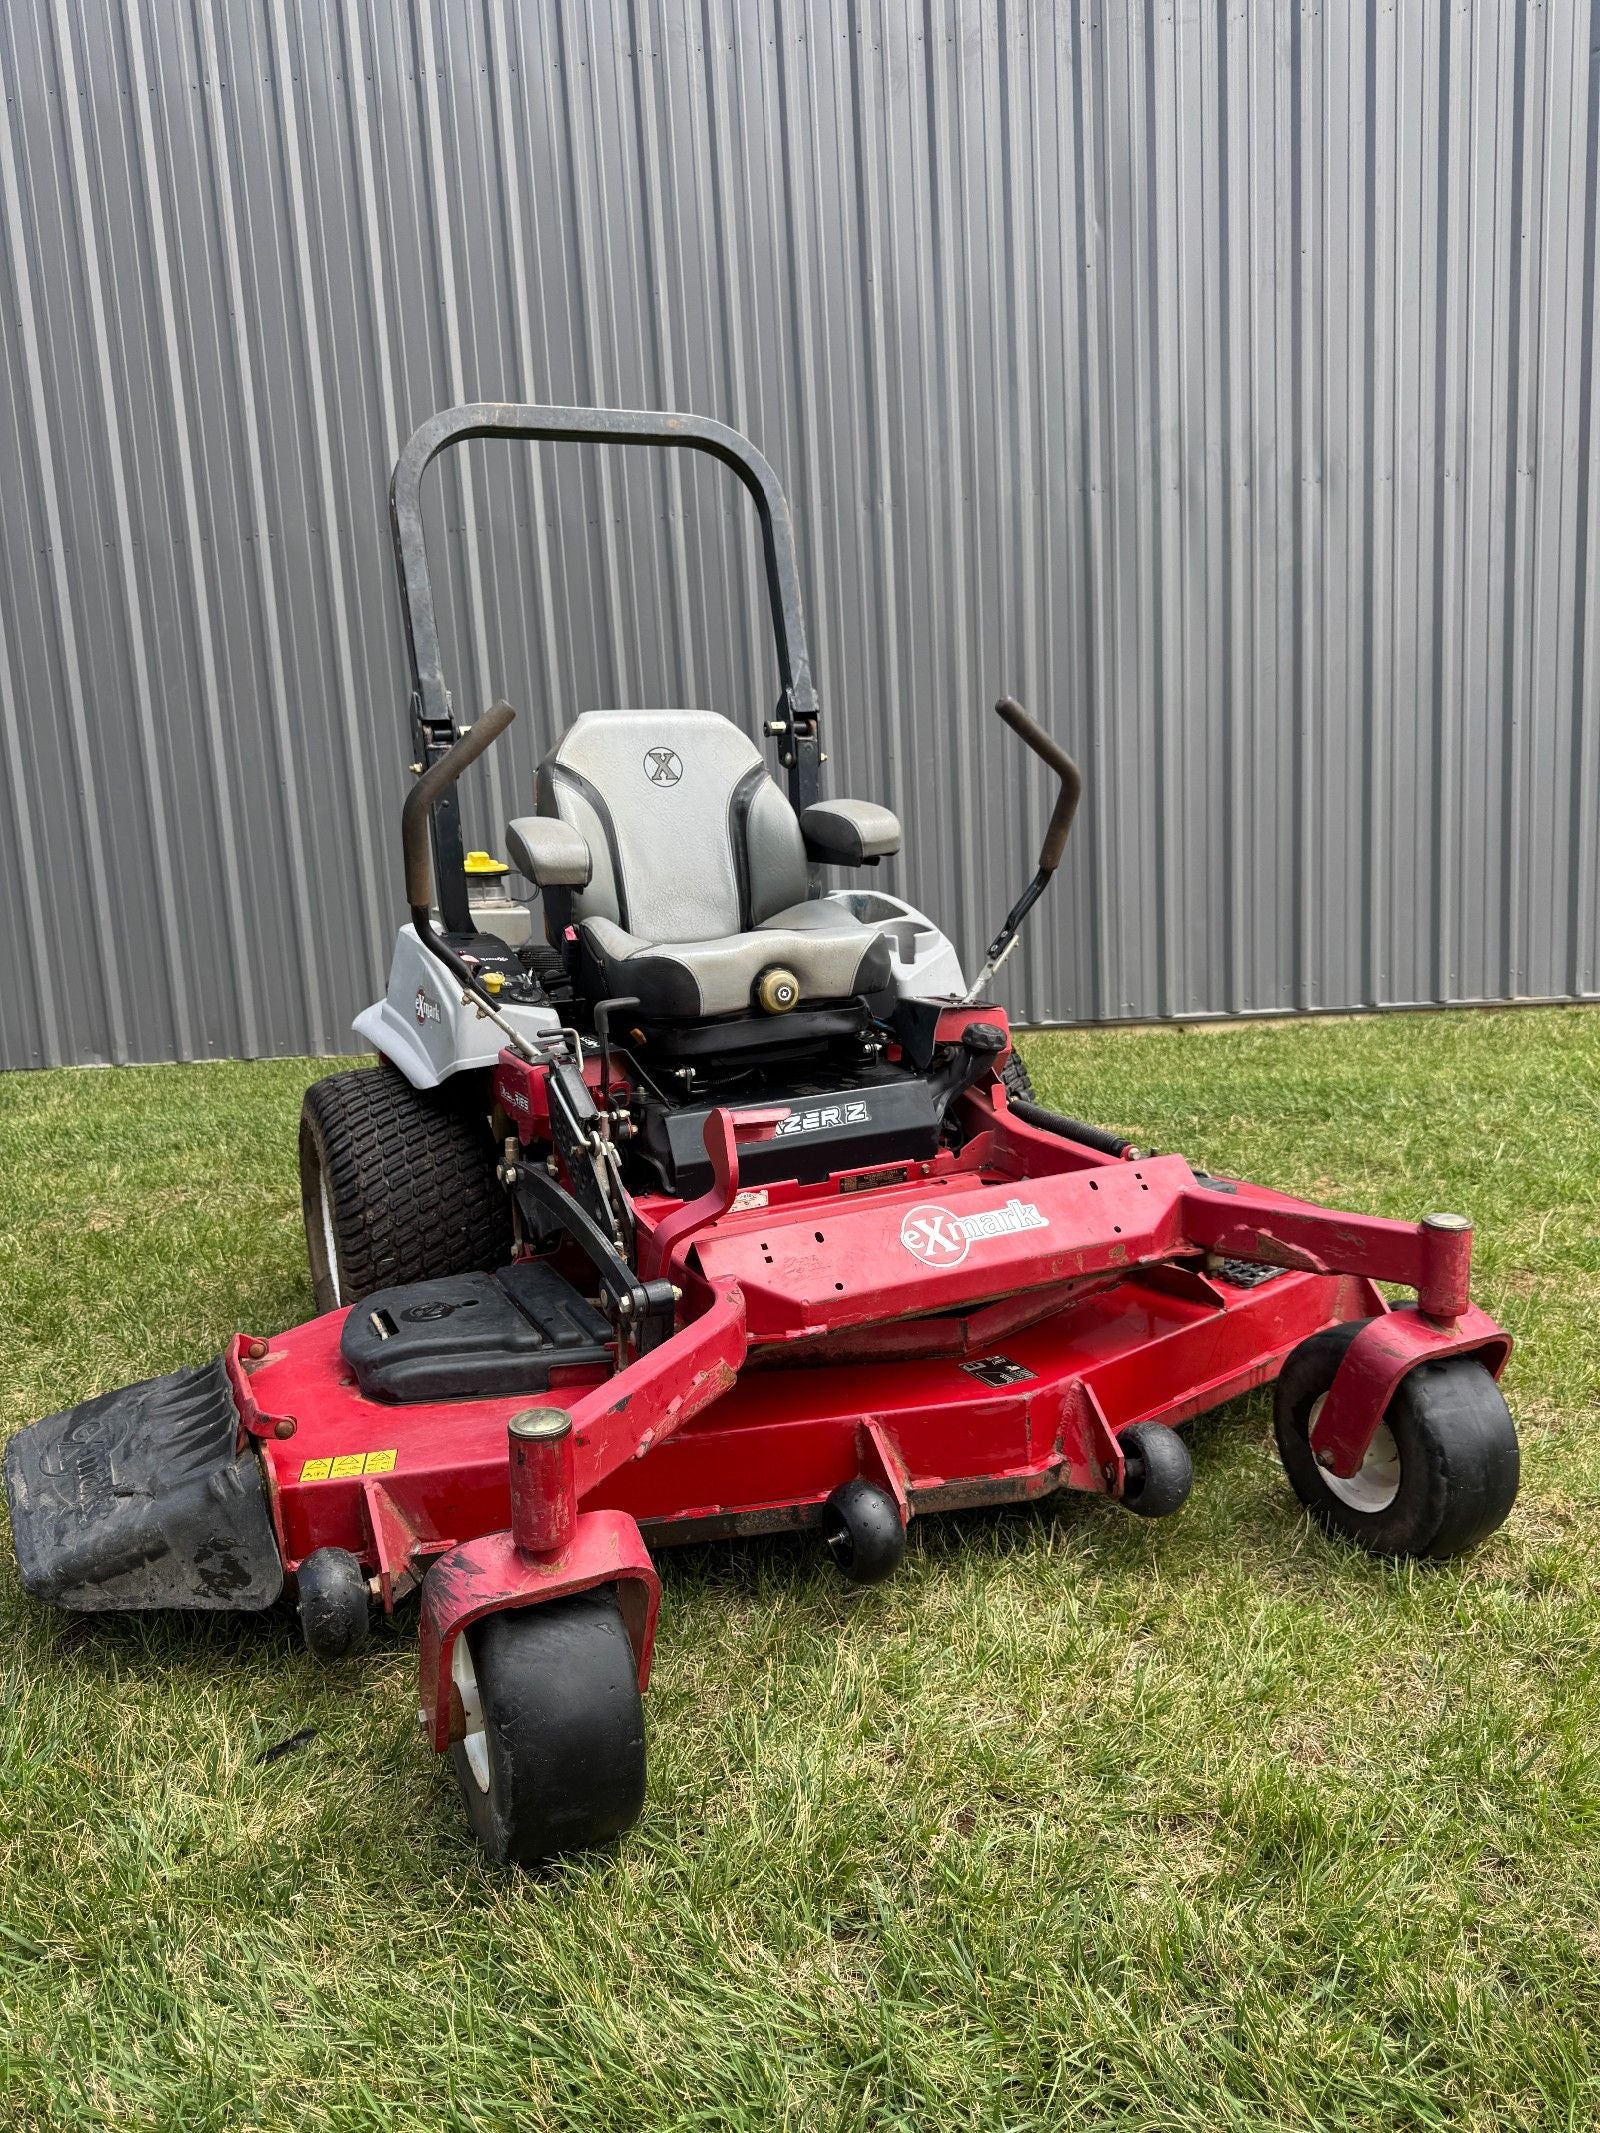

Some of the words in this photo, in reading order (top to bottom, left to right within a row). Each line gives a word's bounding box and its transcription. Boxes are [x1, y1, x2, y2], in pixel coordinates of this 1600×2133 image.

[647, 751, 680, 782] X
[776, 1106, 842, 1136] ZER
[846, 1102, 866, 1122] Z
[902, 1200, 1046, 1258] eXmark
